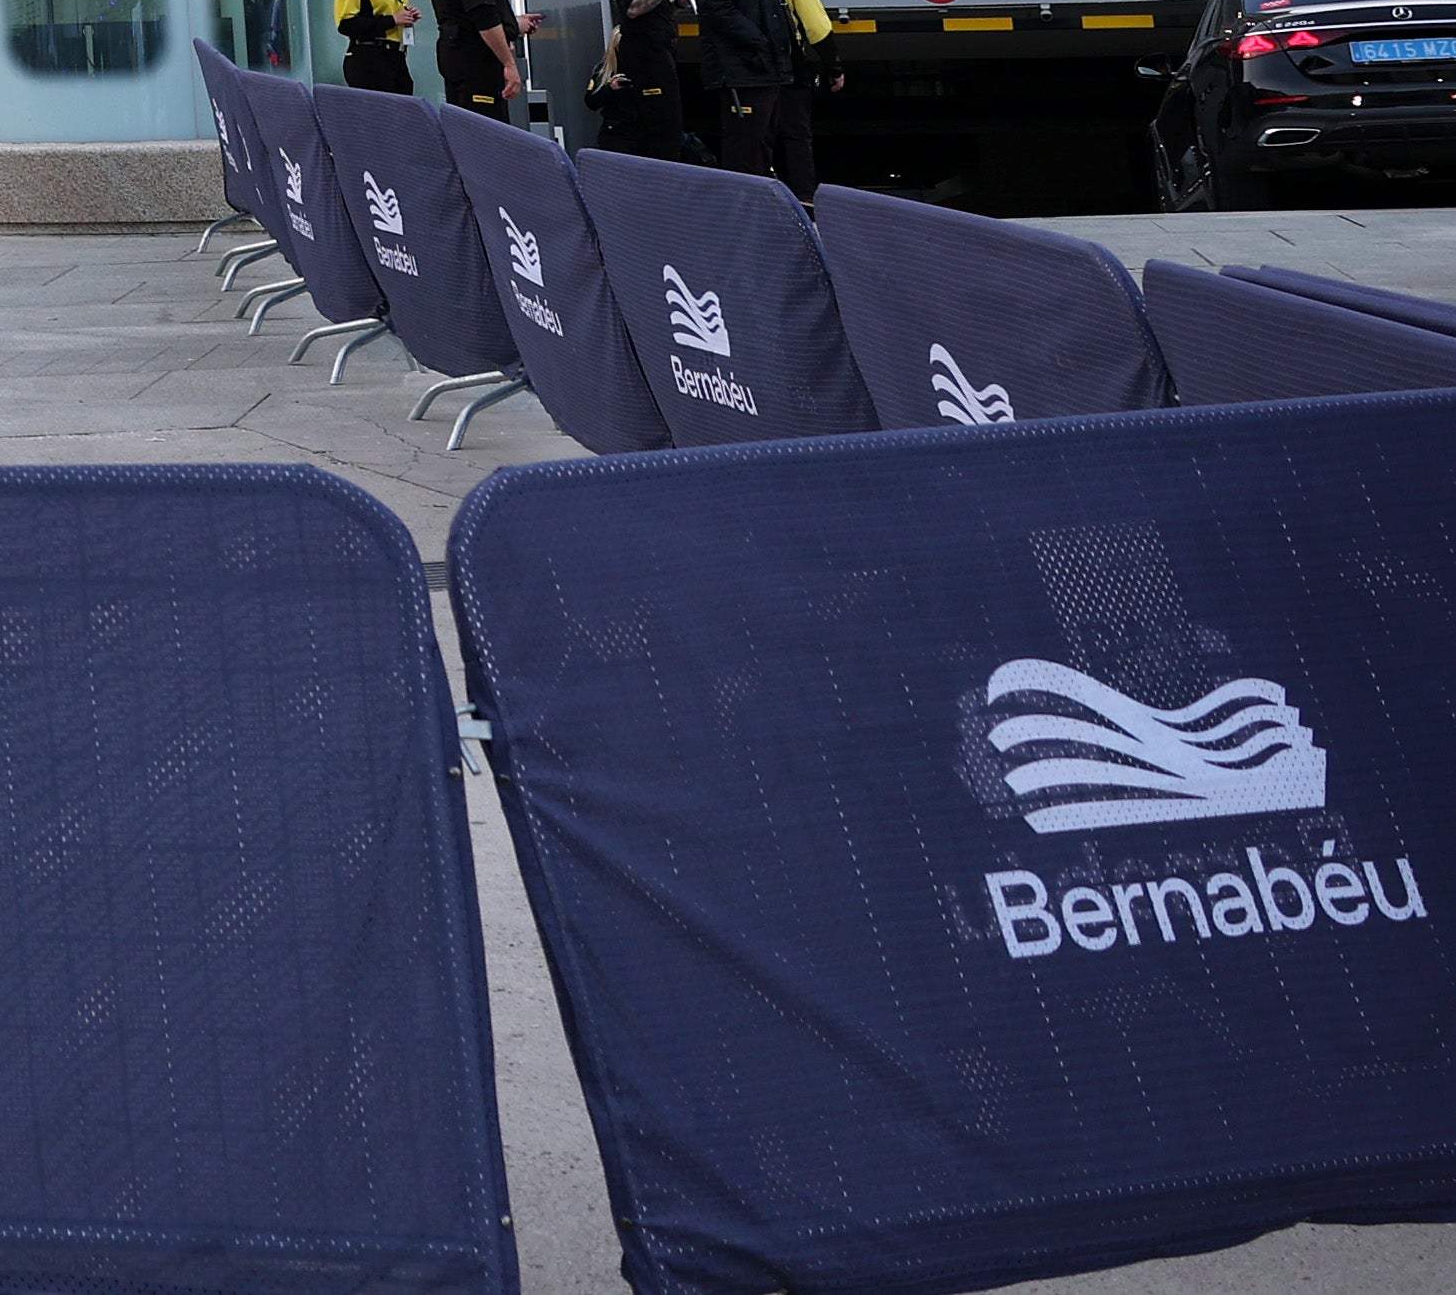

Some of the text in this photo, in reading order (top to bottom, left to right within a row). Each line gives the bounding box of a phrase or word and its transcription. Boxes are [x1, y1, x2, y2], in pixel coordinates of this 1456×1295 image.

[1364, 42, 1418, 59] 6415
[670, 354, 759, 416] Bernabéu
[984, 839, 1429, 960] Bernabéu
